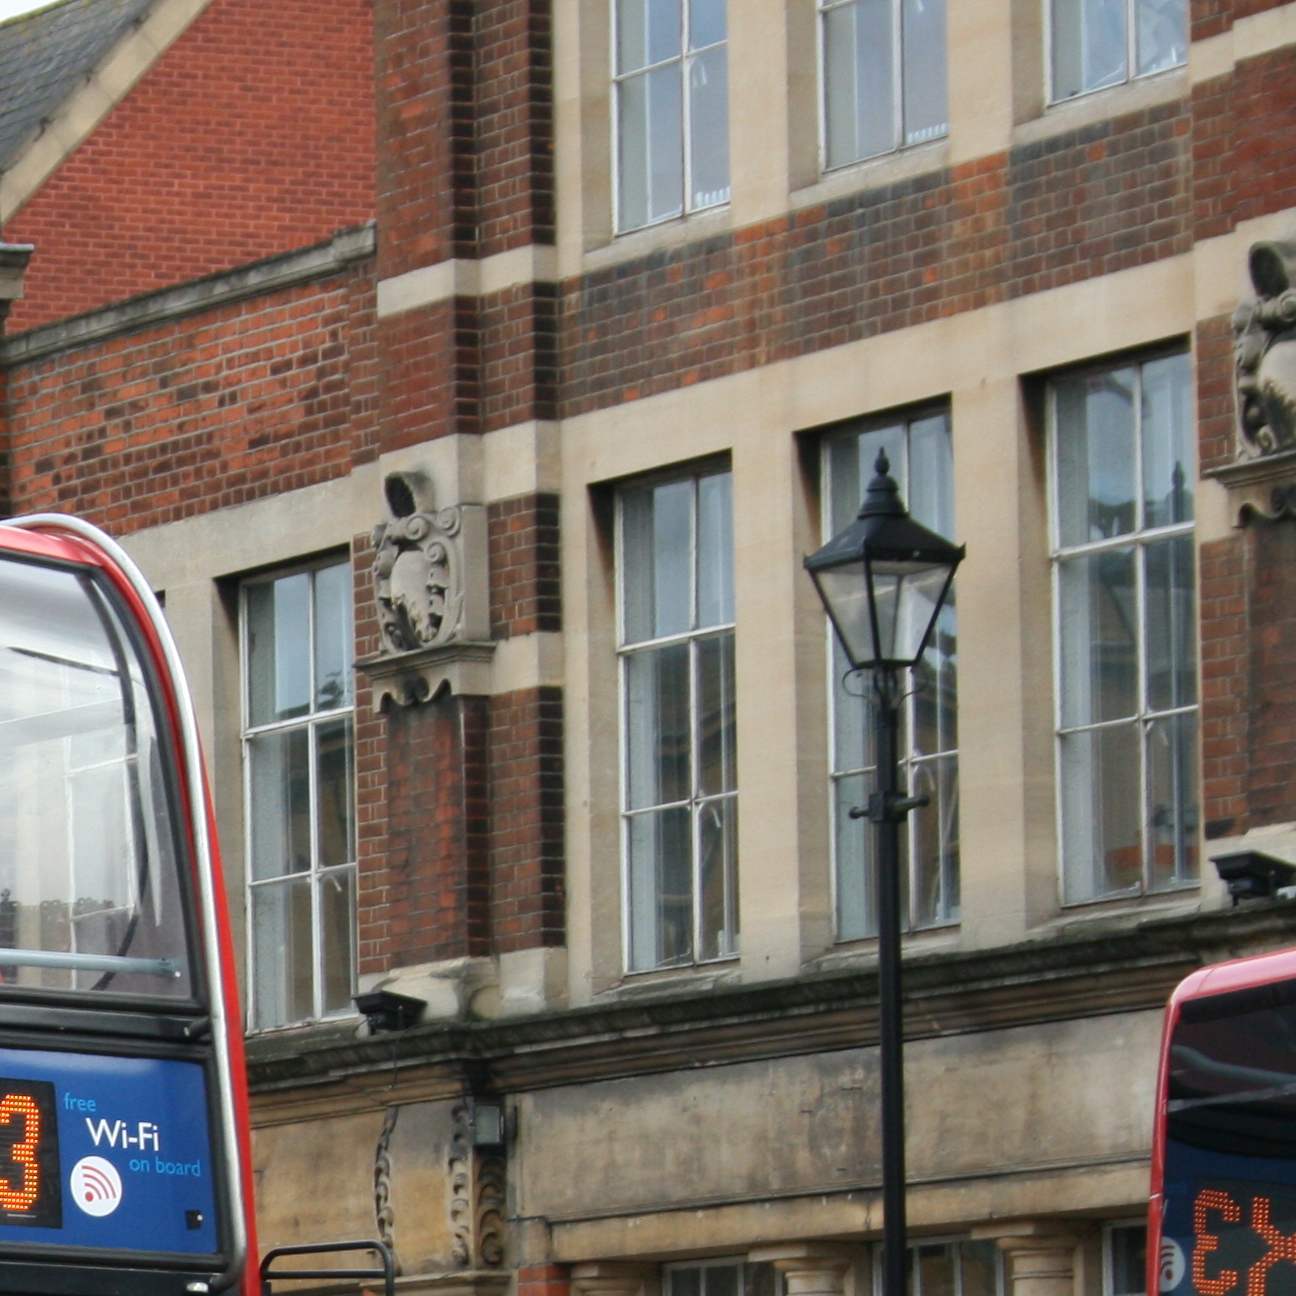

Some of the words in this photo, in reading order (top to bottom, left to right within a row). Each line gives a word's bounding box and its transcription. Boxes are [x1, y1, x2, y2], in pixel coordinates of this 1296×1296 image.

[63, 1092, 97, 1113] free
[84, 1116, 160, 1152] Wi-Fi
[128, 1158, 151, 1173] on
[154, 1156, 202, 1178] board
